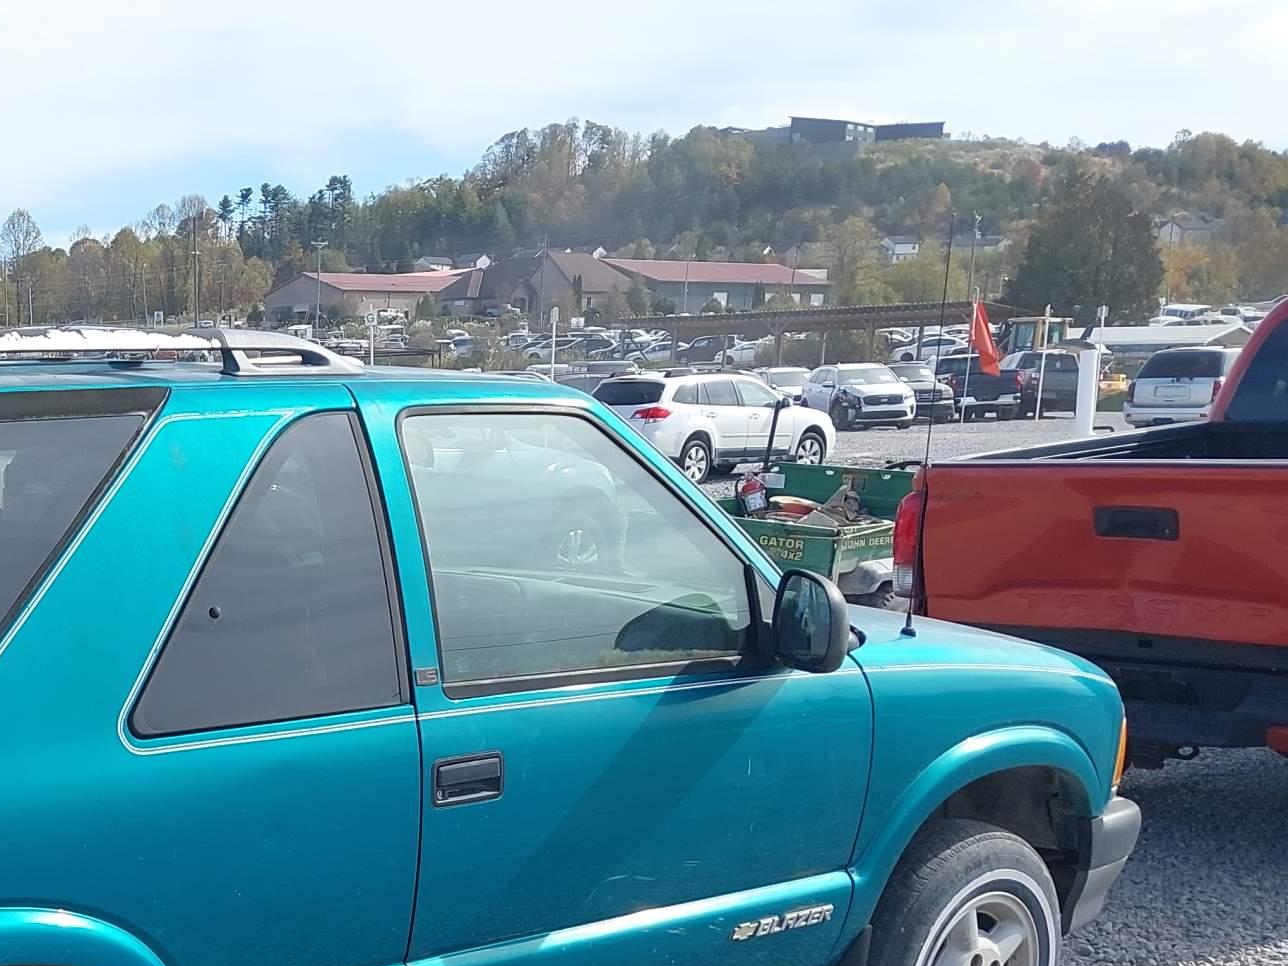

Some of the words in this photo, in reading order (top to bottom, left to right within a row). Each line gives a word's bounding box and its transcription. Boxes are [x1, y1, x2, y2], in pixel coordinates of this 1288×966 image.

[366, 313, 375, 323] G
[759, 535, 804, 550] GATOR
[840, 538, 866, 551] JOHN
[780, 550, 803, 561] 4x2
[416, 669, 438, 685] LS
[756, 904, 834, 937] BLAZER
